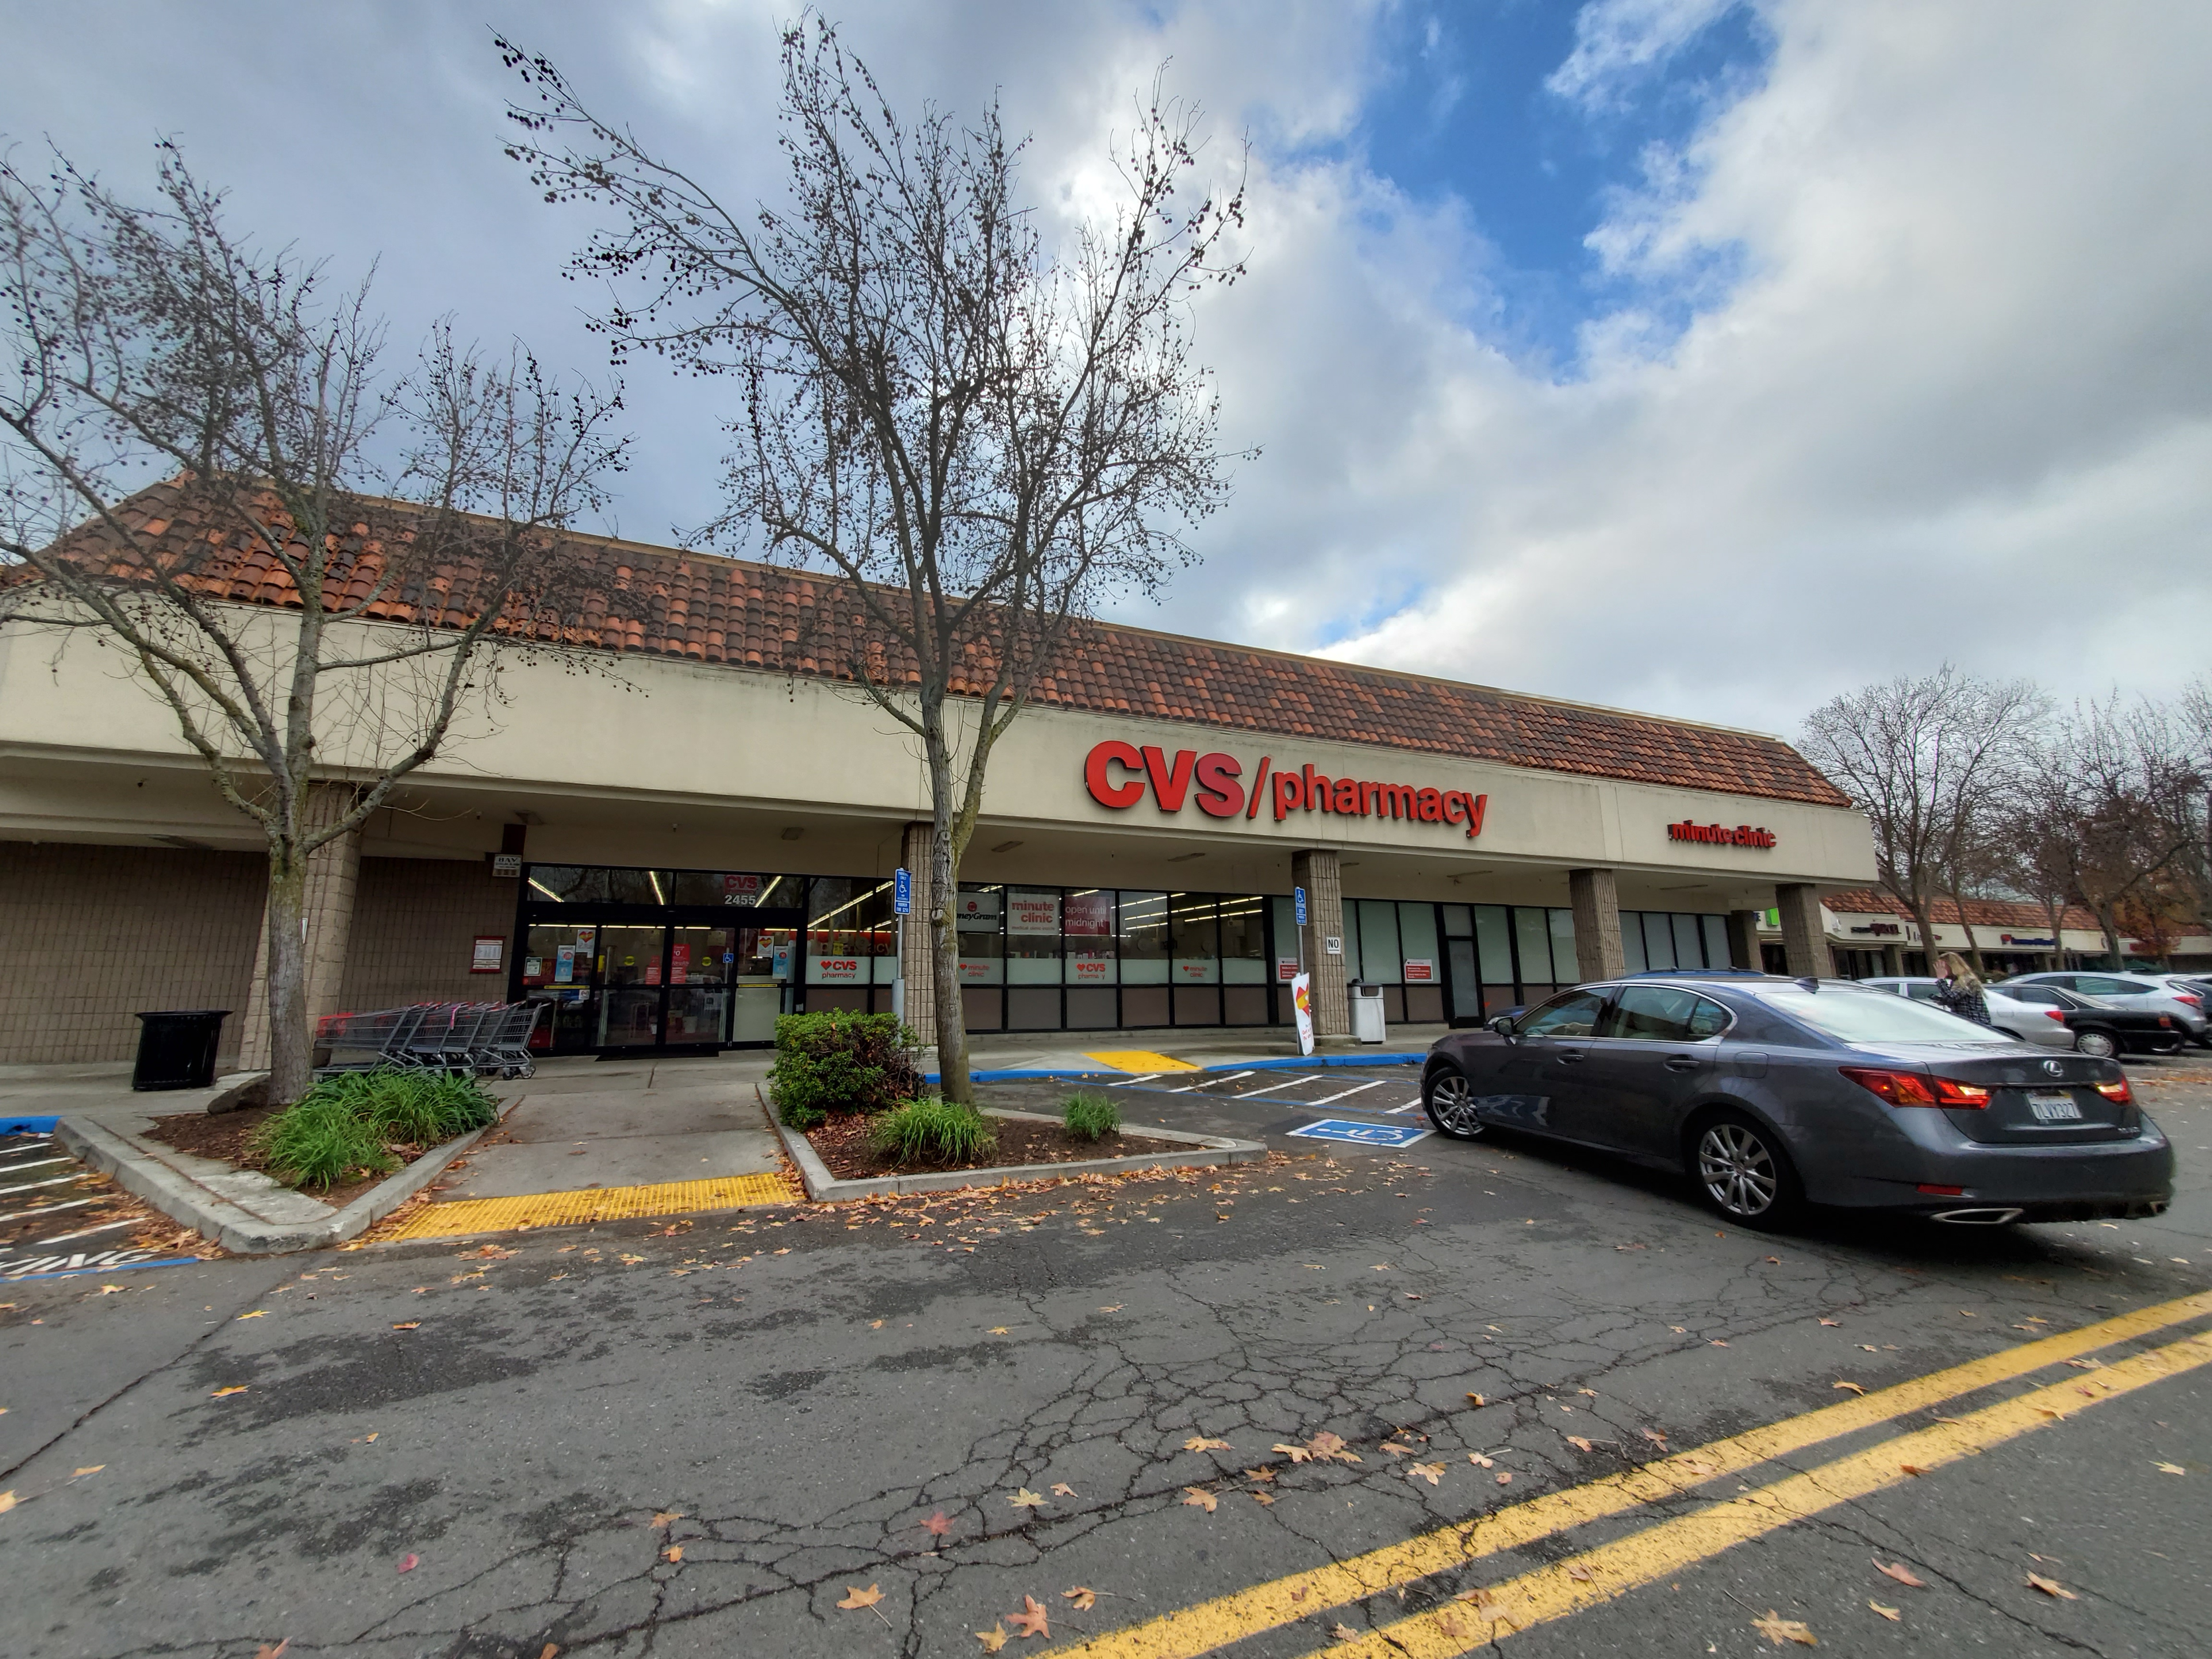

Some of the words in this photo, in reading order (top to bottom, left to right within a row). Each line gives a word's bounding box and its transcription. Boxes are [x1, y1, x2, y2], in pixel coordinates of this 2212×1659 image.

[1667, 820, 1733, 843] minute
[1734, 825, 1777, 847] clinic
[725, 875, 757, 889] CVS
[724, 895, 756, 905] 2455
[1012, 901, 1054, 911] minute
[1065, 906, 1087, 915] open
[1090, 906, 1106, 914] until
[956, 912, 997, 921] neyGram
[1021, 913, 1052, 923] clinic
[1065, 918, 1104, 929] midnight
[1328, 939, 1339, 948] NO
[833, 960, 857, 971] CVS
[1086, 964, 1106, 972] CVS
